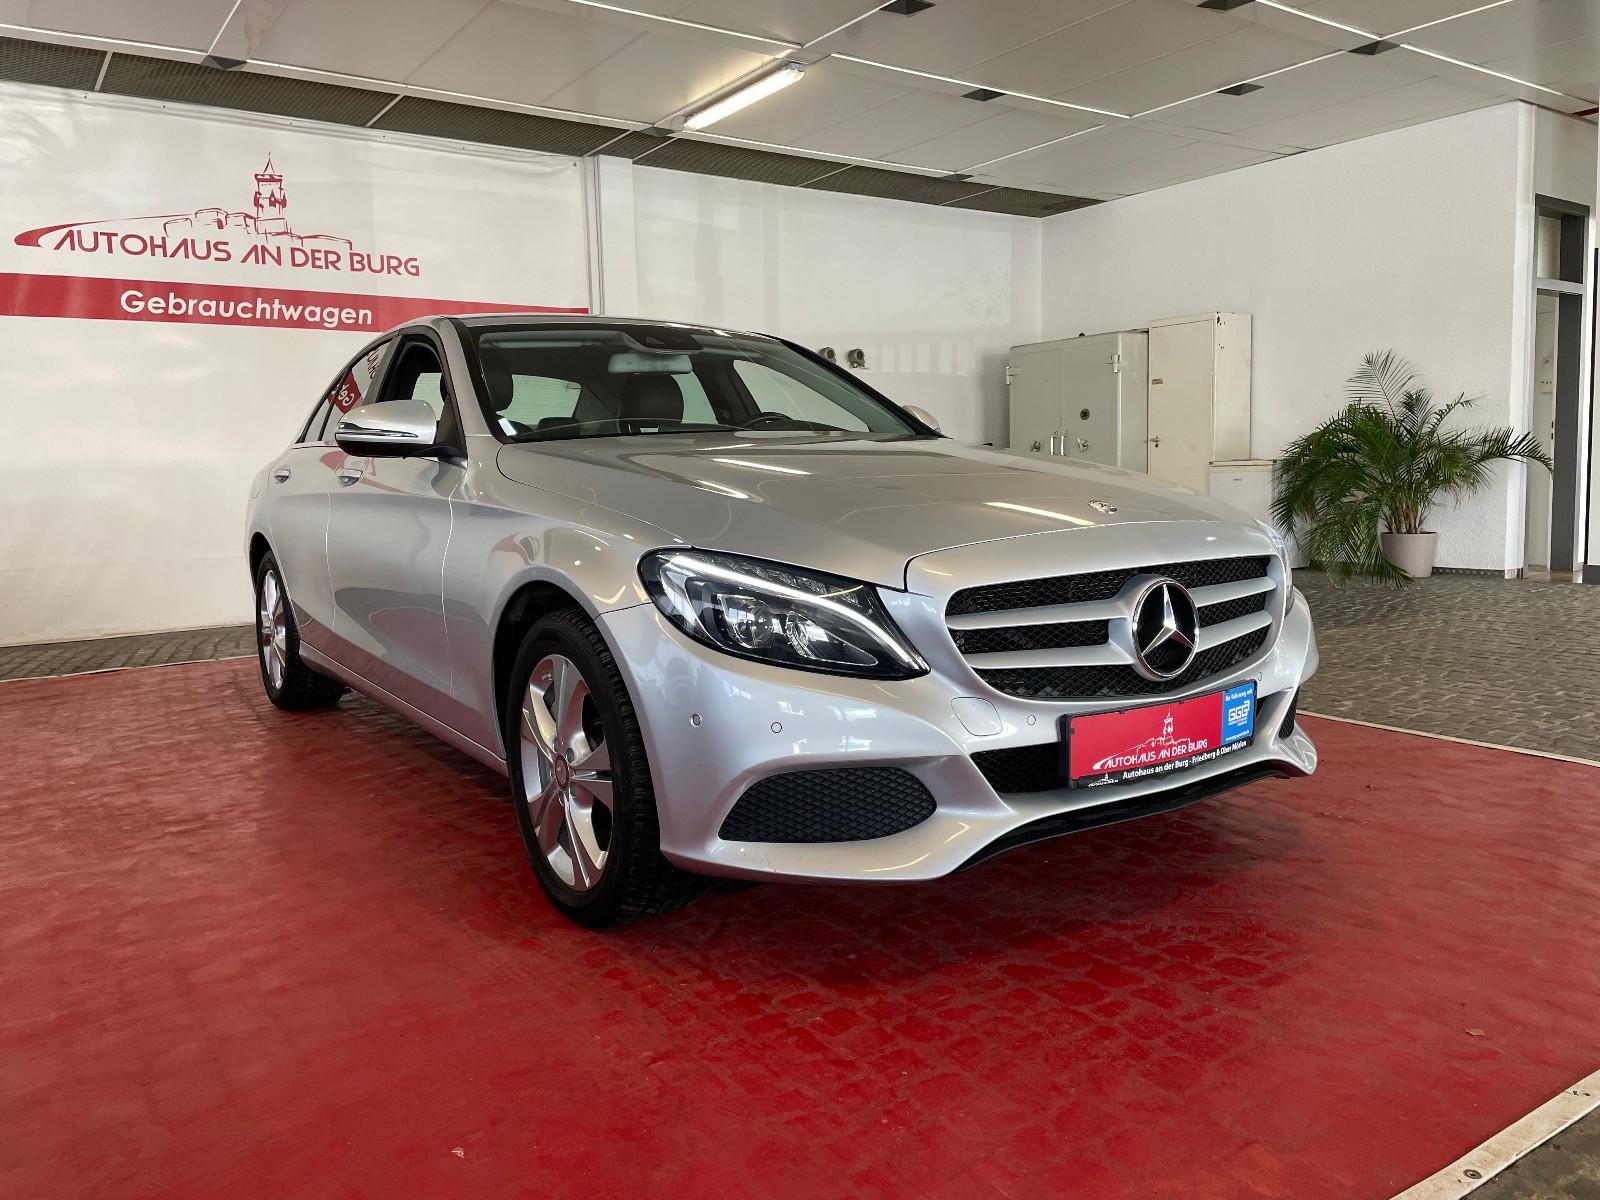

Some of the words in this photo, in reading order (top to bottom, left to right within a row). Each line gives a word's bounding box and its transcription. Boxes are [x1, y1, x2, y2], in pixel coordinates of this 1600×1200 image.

[53, 229, 231, 262] AUTOHAUS
[240, 243, 281, 266] AN
[291, 247, 341, 272] DER
[349, 252, 420, 277] BURG
[119, 289, 374, 327] Gebrauchtwagen
[1104, 753, 1156, 769] AUTOHAUS
[1158, 750, 1171, 759] AN
[1172, 747, 1187, 757] DER
[1188, 739, 1208, 753] BURG
[1122, 765, 1155, 780] Autohaus
[1155, 763, 1164, 772] an
[1164, 762, 1174, 771] der
[1175, 760, 1189, 769] Burg
[1192, 752, 1216, 764] Friedberg
